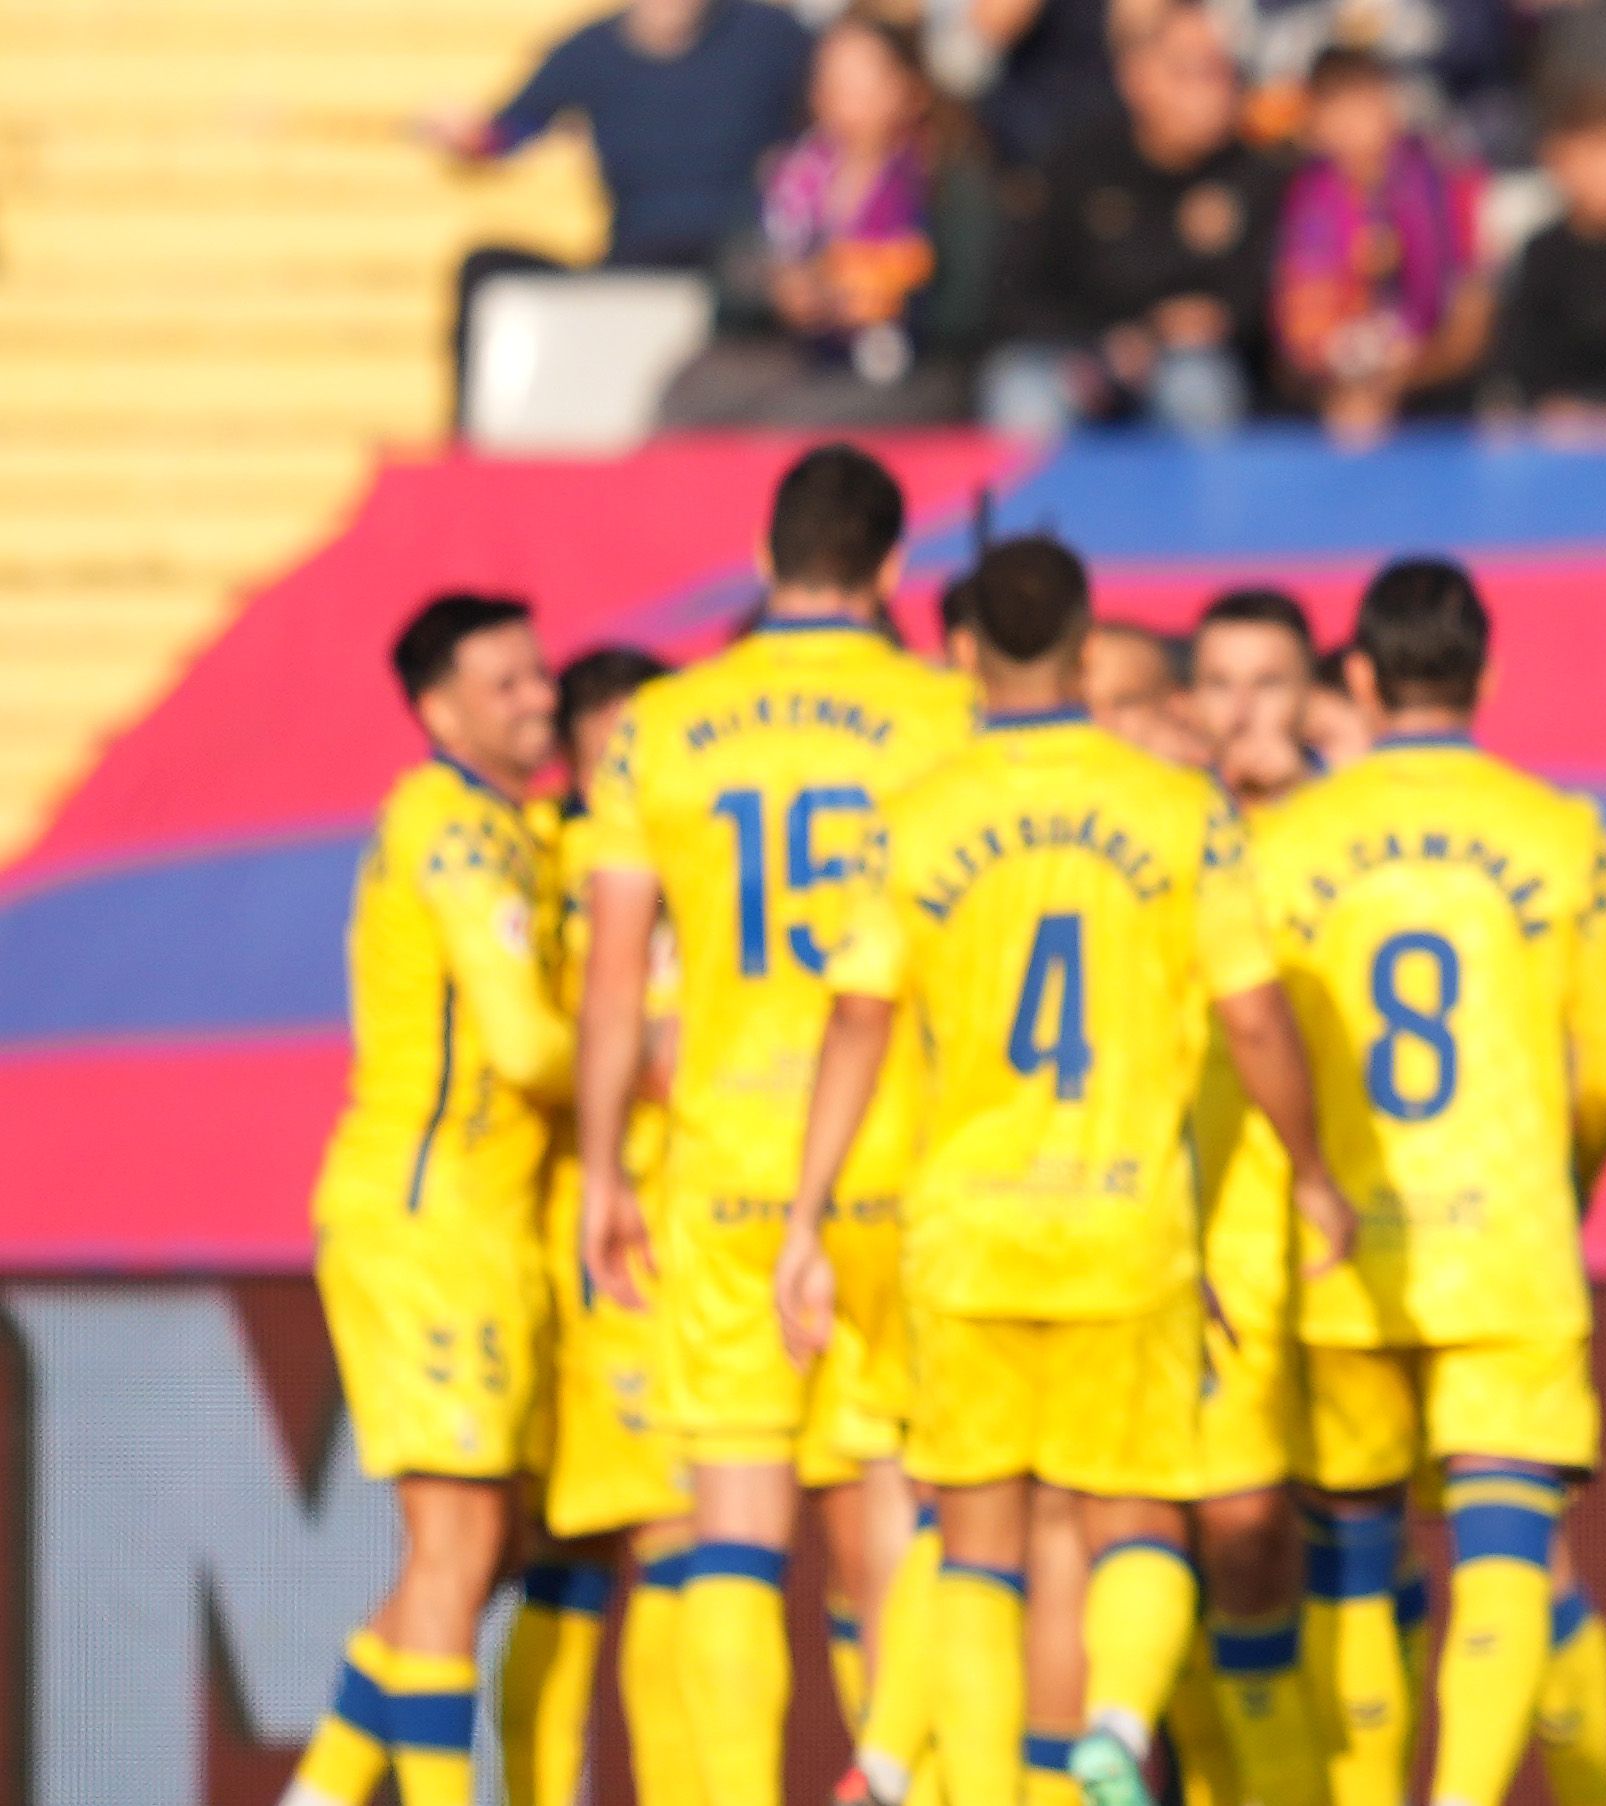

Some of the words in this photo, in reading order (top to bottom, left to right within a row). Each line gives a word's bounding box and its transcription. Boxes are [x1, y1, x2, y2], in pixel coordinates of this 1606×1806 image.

[712, 787, 875, 978] 15
[1006, 913, 1092, 1101] 4
[1366, 930, 1460, 1121] 8
